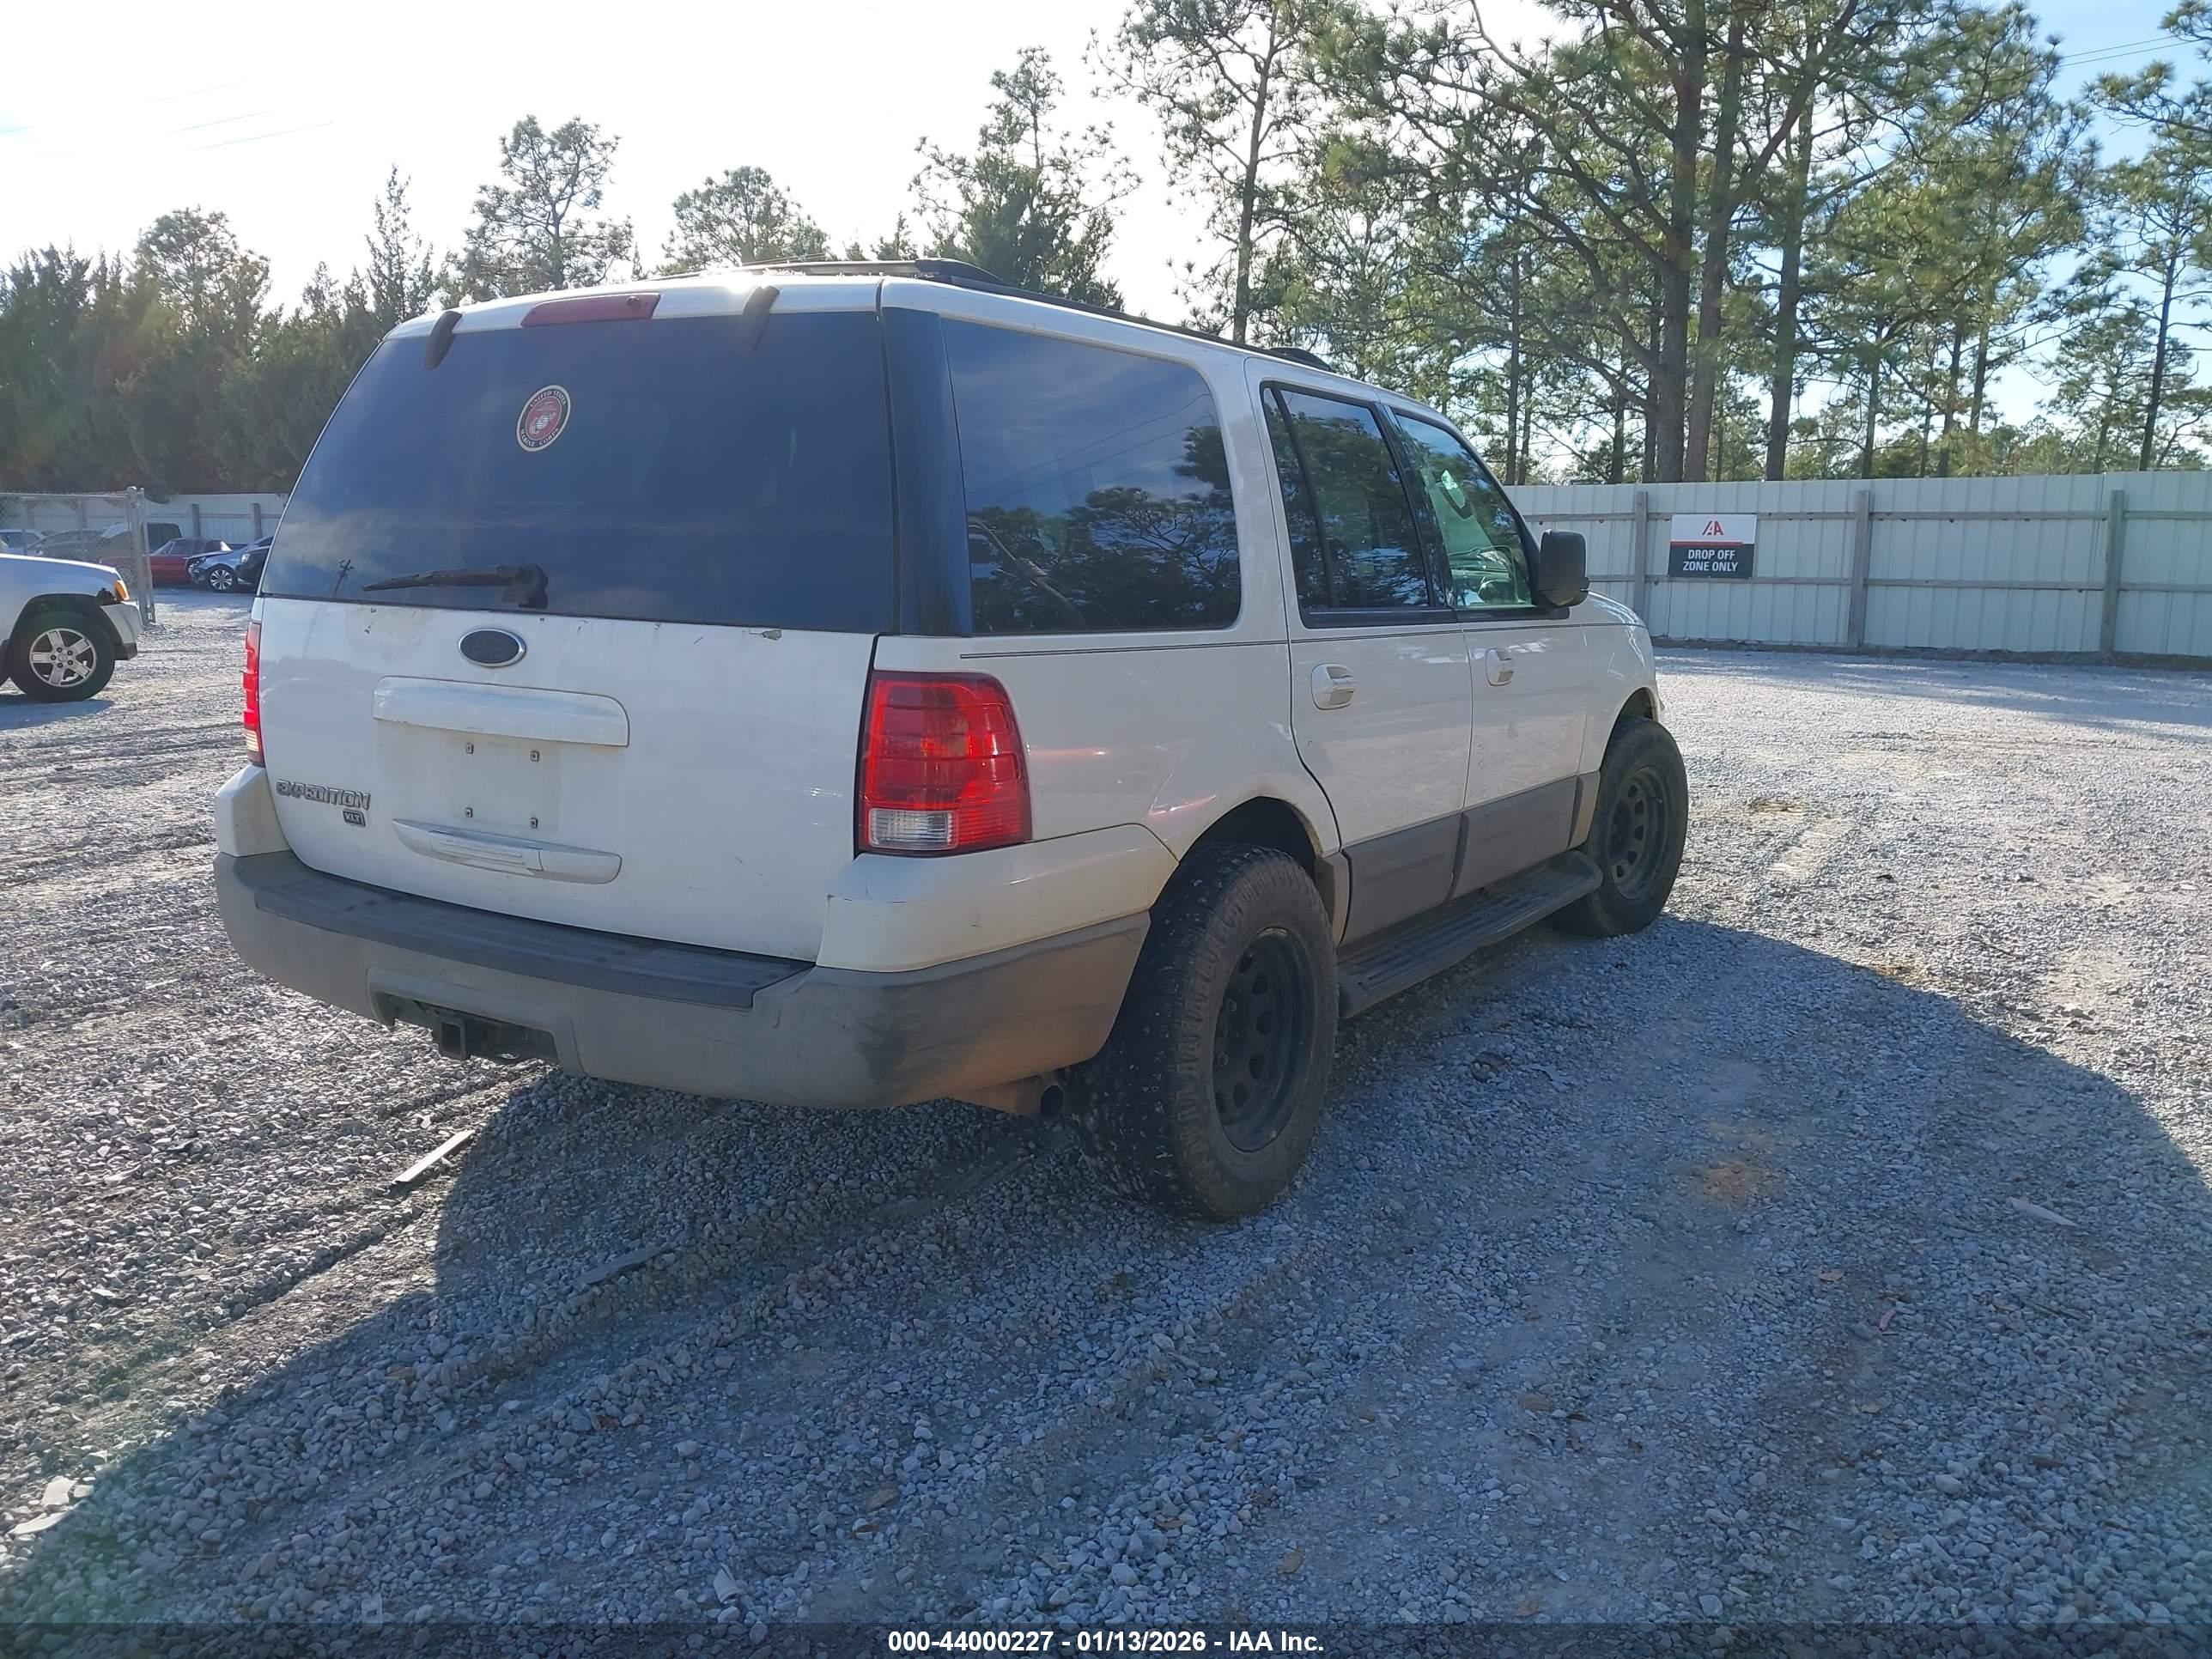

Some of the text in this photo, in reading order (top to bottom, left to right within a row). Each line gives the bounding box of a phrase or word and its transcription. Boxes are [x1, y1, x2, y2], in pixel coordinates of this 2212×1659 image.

[530, 391, 552, 407] UNITED
[520, 428, 560, 447] MARINE CORPS
[1687, 550, 1735, 560] DROP OFF
[1683, 561, 1738, 572] ZONE ONLY
[276, 779, 371, 811] EXPEDITION
[344, 812, 361, 823] XLT
